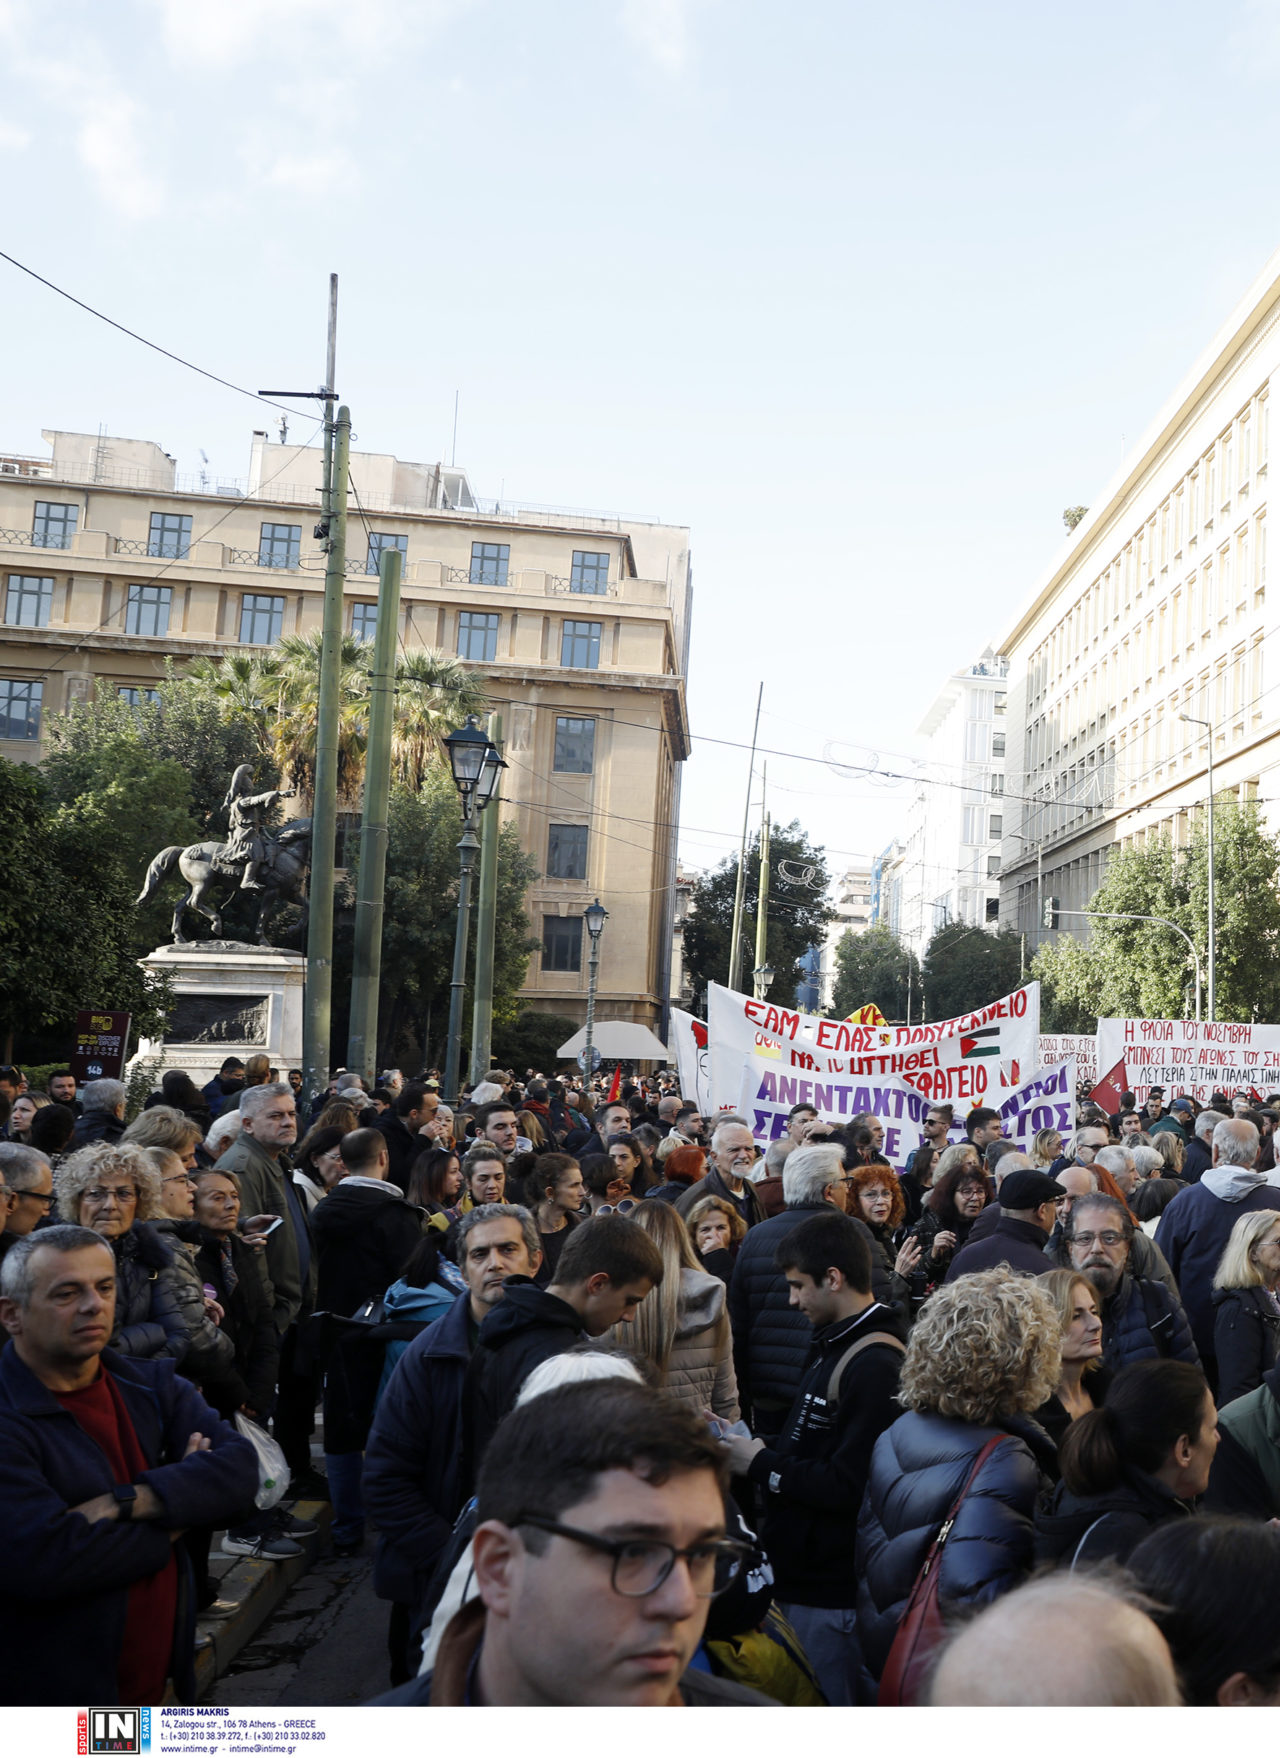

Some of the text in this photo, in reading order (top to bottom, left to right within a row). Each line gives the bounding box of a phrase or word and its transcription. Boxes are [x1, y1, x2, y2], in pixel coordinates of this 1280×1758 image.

[744, 1000, 799, 1040] ΕΑΜ
[816, 1021, 877, 1052] ΕΛΑΣ
[1125, 1020, 1251, 1044] Η ΦΛΟΓΑ ΤΟΥ ΝΟΕΜΒΡΗ
[1122, 1046, 1165, 1066] ΕΜΠΝΕΕΙ
[1170, 1047, 1194, 1064] ΤΟΥΣ
[1198, 1049, 1238, 1066] ΑΓΩΝΕΣ
[1242, 1051, 1259, 1065] ΤΟΥ
[1139, 1067, 1186, 1084] ΛΕΥΤΕΡΙΑ
[1190, 1067, 1218, 1081] ΣΤΗΝ
